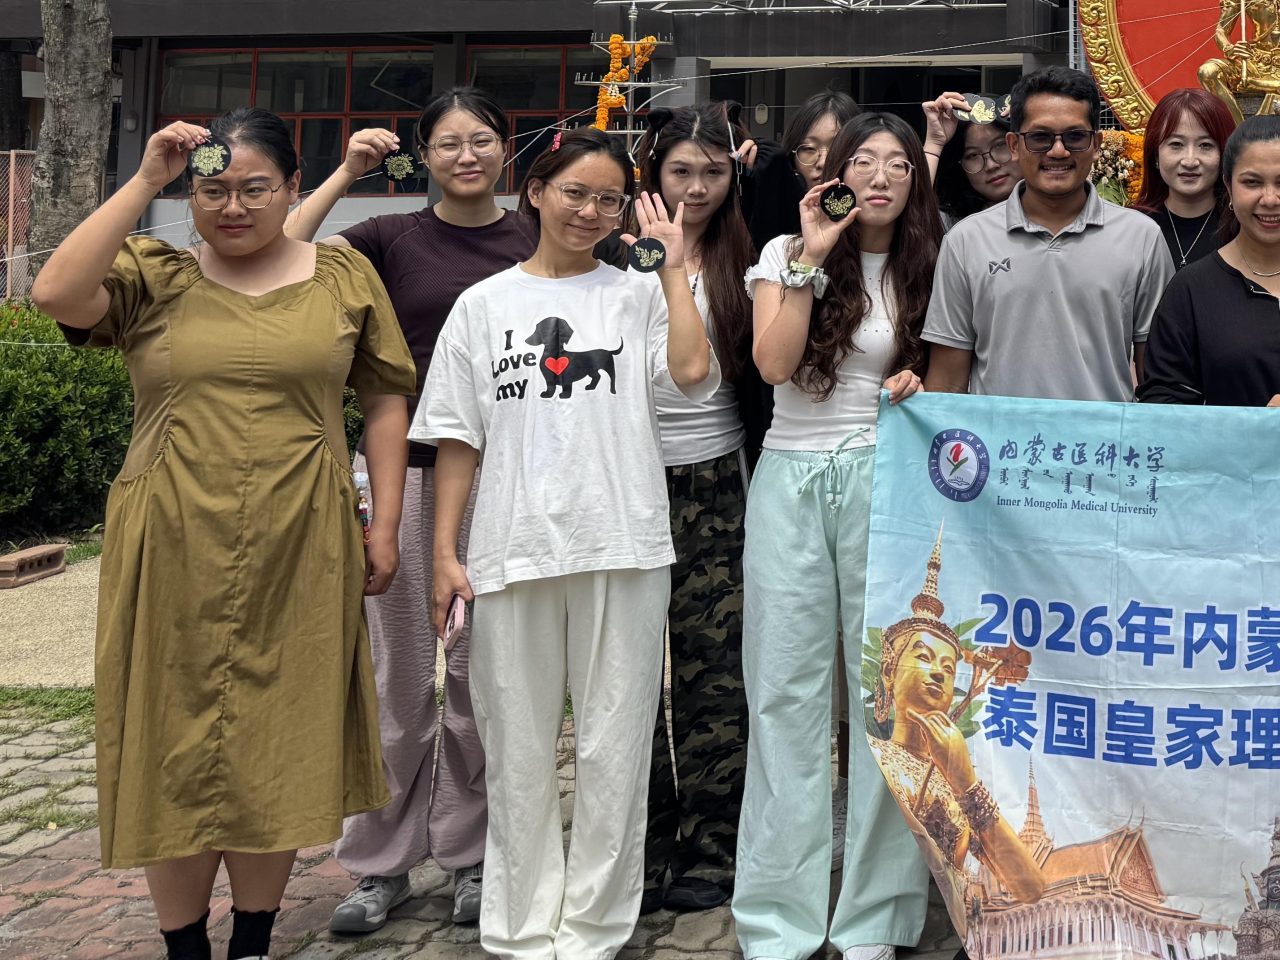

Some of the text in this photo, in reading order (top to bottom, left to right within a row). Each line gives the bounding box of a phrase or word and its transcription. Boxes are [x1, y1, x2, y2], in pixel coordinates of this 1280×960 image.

[504, 329, 514, 351] I
[491, 352, 537, 379] Love
[496, 378, 529, 402] my
[998, 432, 1165, 472] 内蒙古医科大学
[996, 495, 1158, 518] Inner Mongolia Medical University
